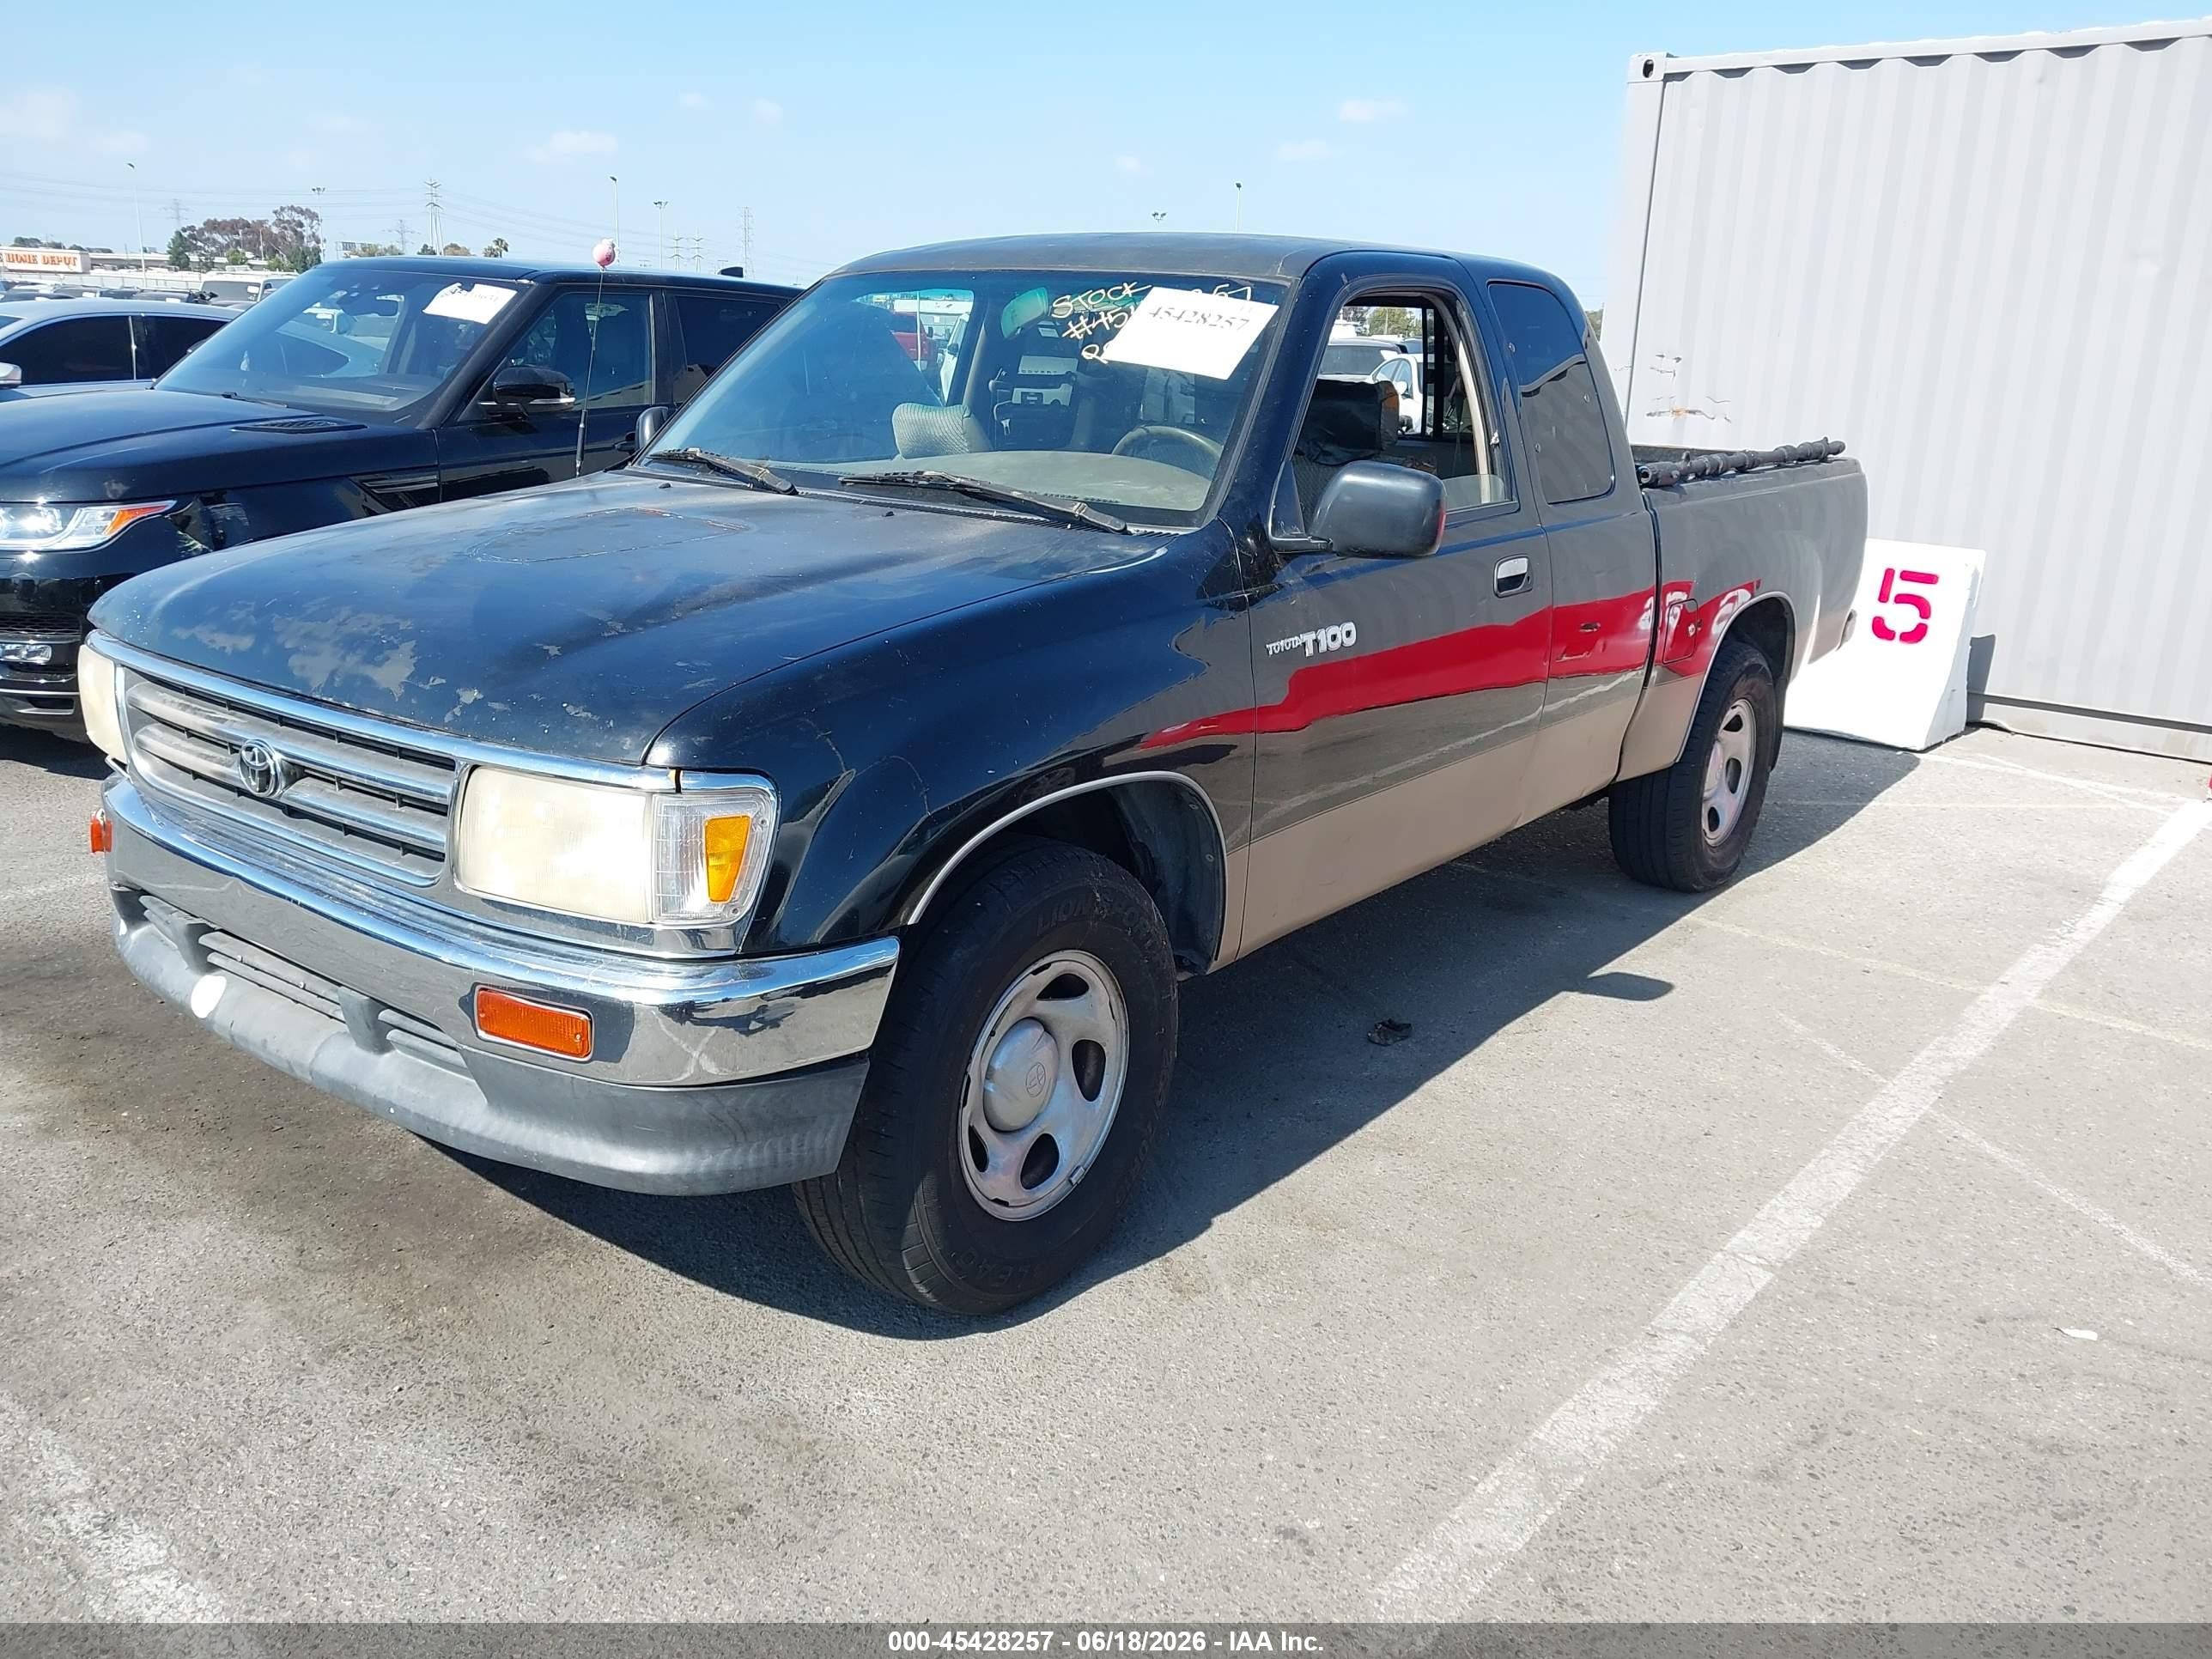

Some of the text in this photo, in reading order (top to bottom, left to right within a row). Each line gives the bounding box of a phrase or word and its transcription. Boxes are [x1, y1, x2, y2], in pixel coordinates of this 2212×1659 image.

[1051, 281, 1152, 319] STOCK
[1149, 306, 1250, 331] 45428257
[1871, 568, 1939, 644] 5
[1266, 621, 1357, 658] TOYOTA T100
